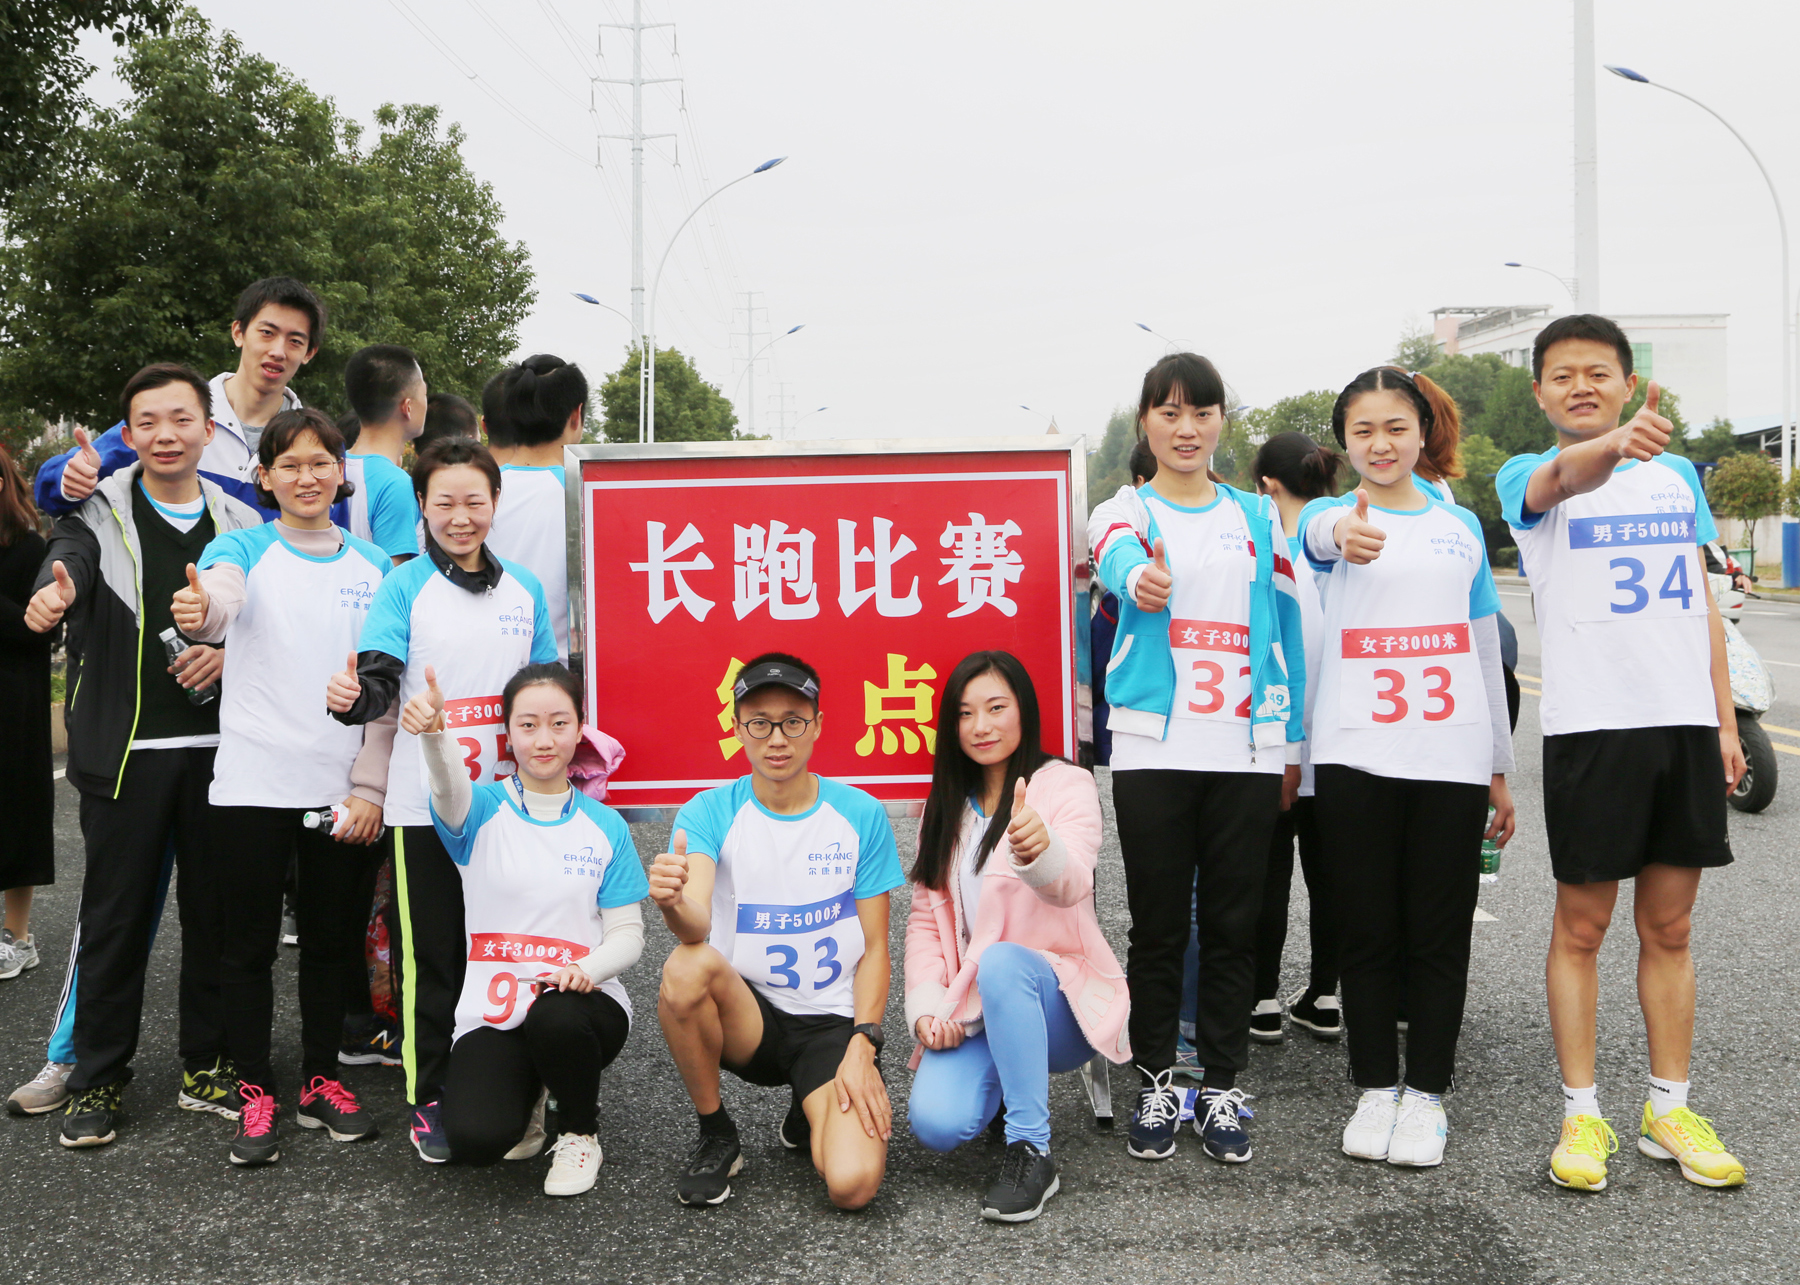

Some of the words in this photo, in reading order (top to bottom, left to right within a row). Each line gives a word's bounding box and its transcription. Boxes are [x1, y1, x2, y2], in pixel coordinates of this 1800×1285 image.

[1593, 520, 1690, 543] 男子5000米
[628, 511, 1026, 625] 长跑比赛
[1609, 555, 1693, 614] 34
[1359, 632, 1458, 654] 女子3000米
[1269, 692, 1285, 706] 49
[1371, 666, 1455, 723] 33
[808, 851, 853, 861] ER-KANG
[753, 902, 842, 930] 男子5000米
[482, 940, 573, 964] 女子3000米
[765, 936, 843, 991] 33
